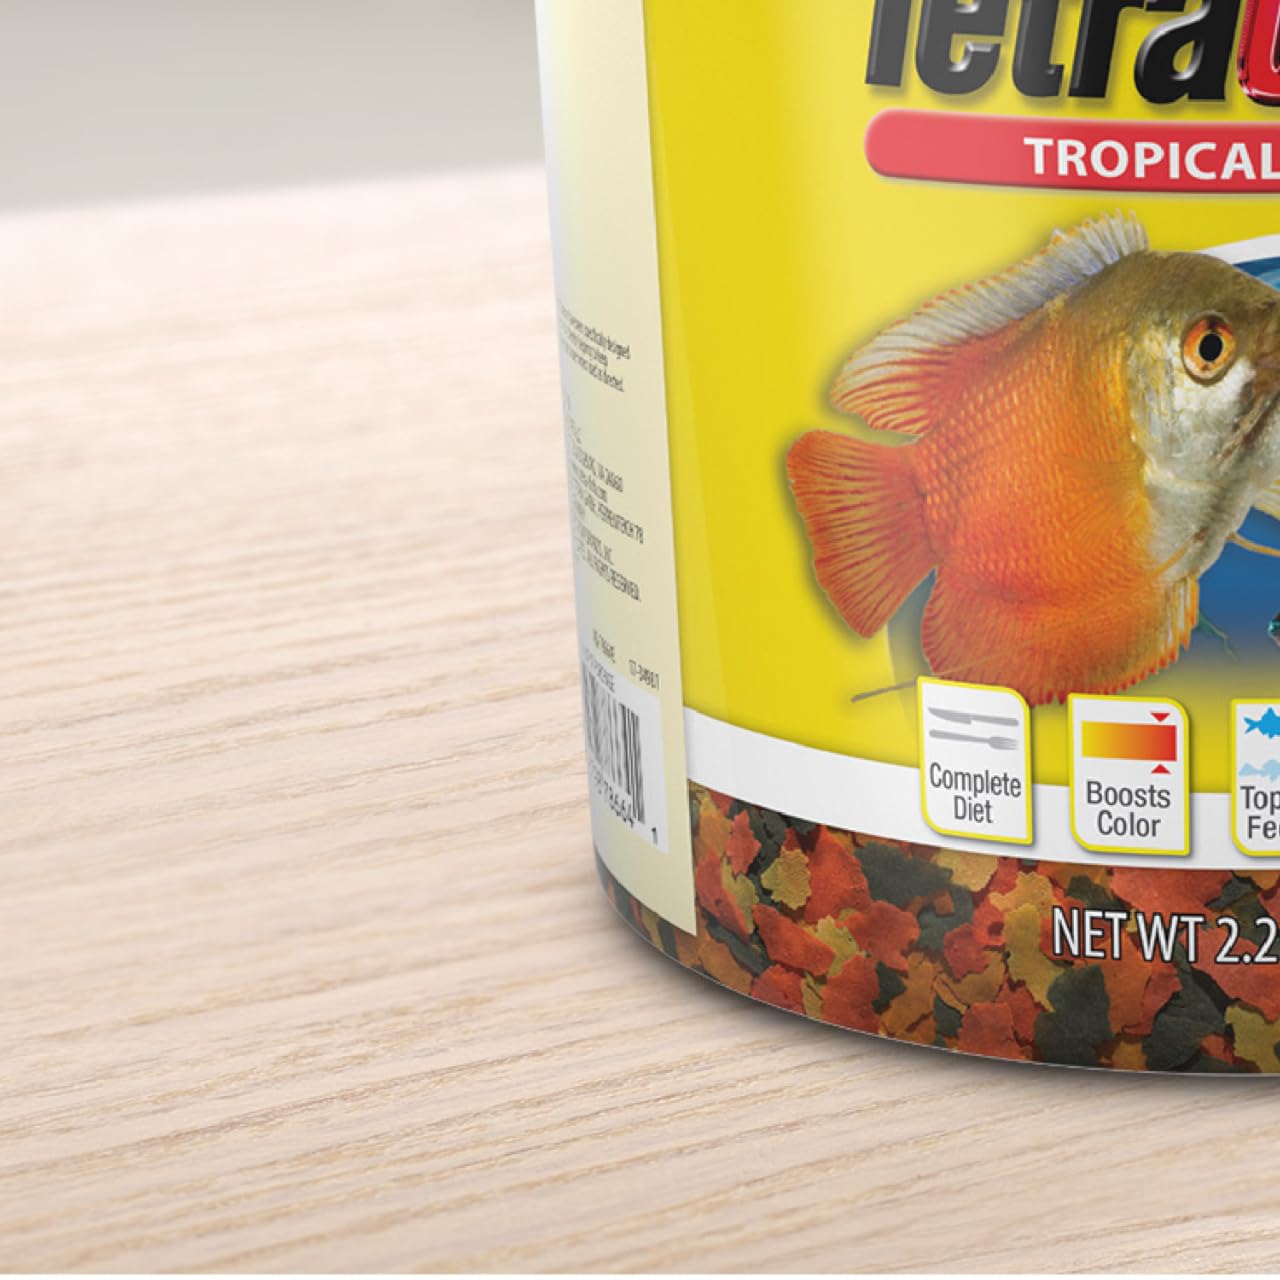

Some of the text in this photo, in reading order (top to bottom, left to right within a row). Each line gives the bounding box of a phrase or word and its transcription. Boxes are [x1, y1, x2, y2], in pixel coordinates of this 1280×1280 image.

[929, 761, 1022, 801] Complete
[1086, 780, 1171, 810] Boosts
[953, 796, 994, 825] Diet
[1097, 809, 1161, 838] Color
[1052, 906, 1128, 960] NET
[1136, 911, 1205, 963] WT
[1215, 915, 1279, 965] 2.2
